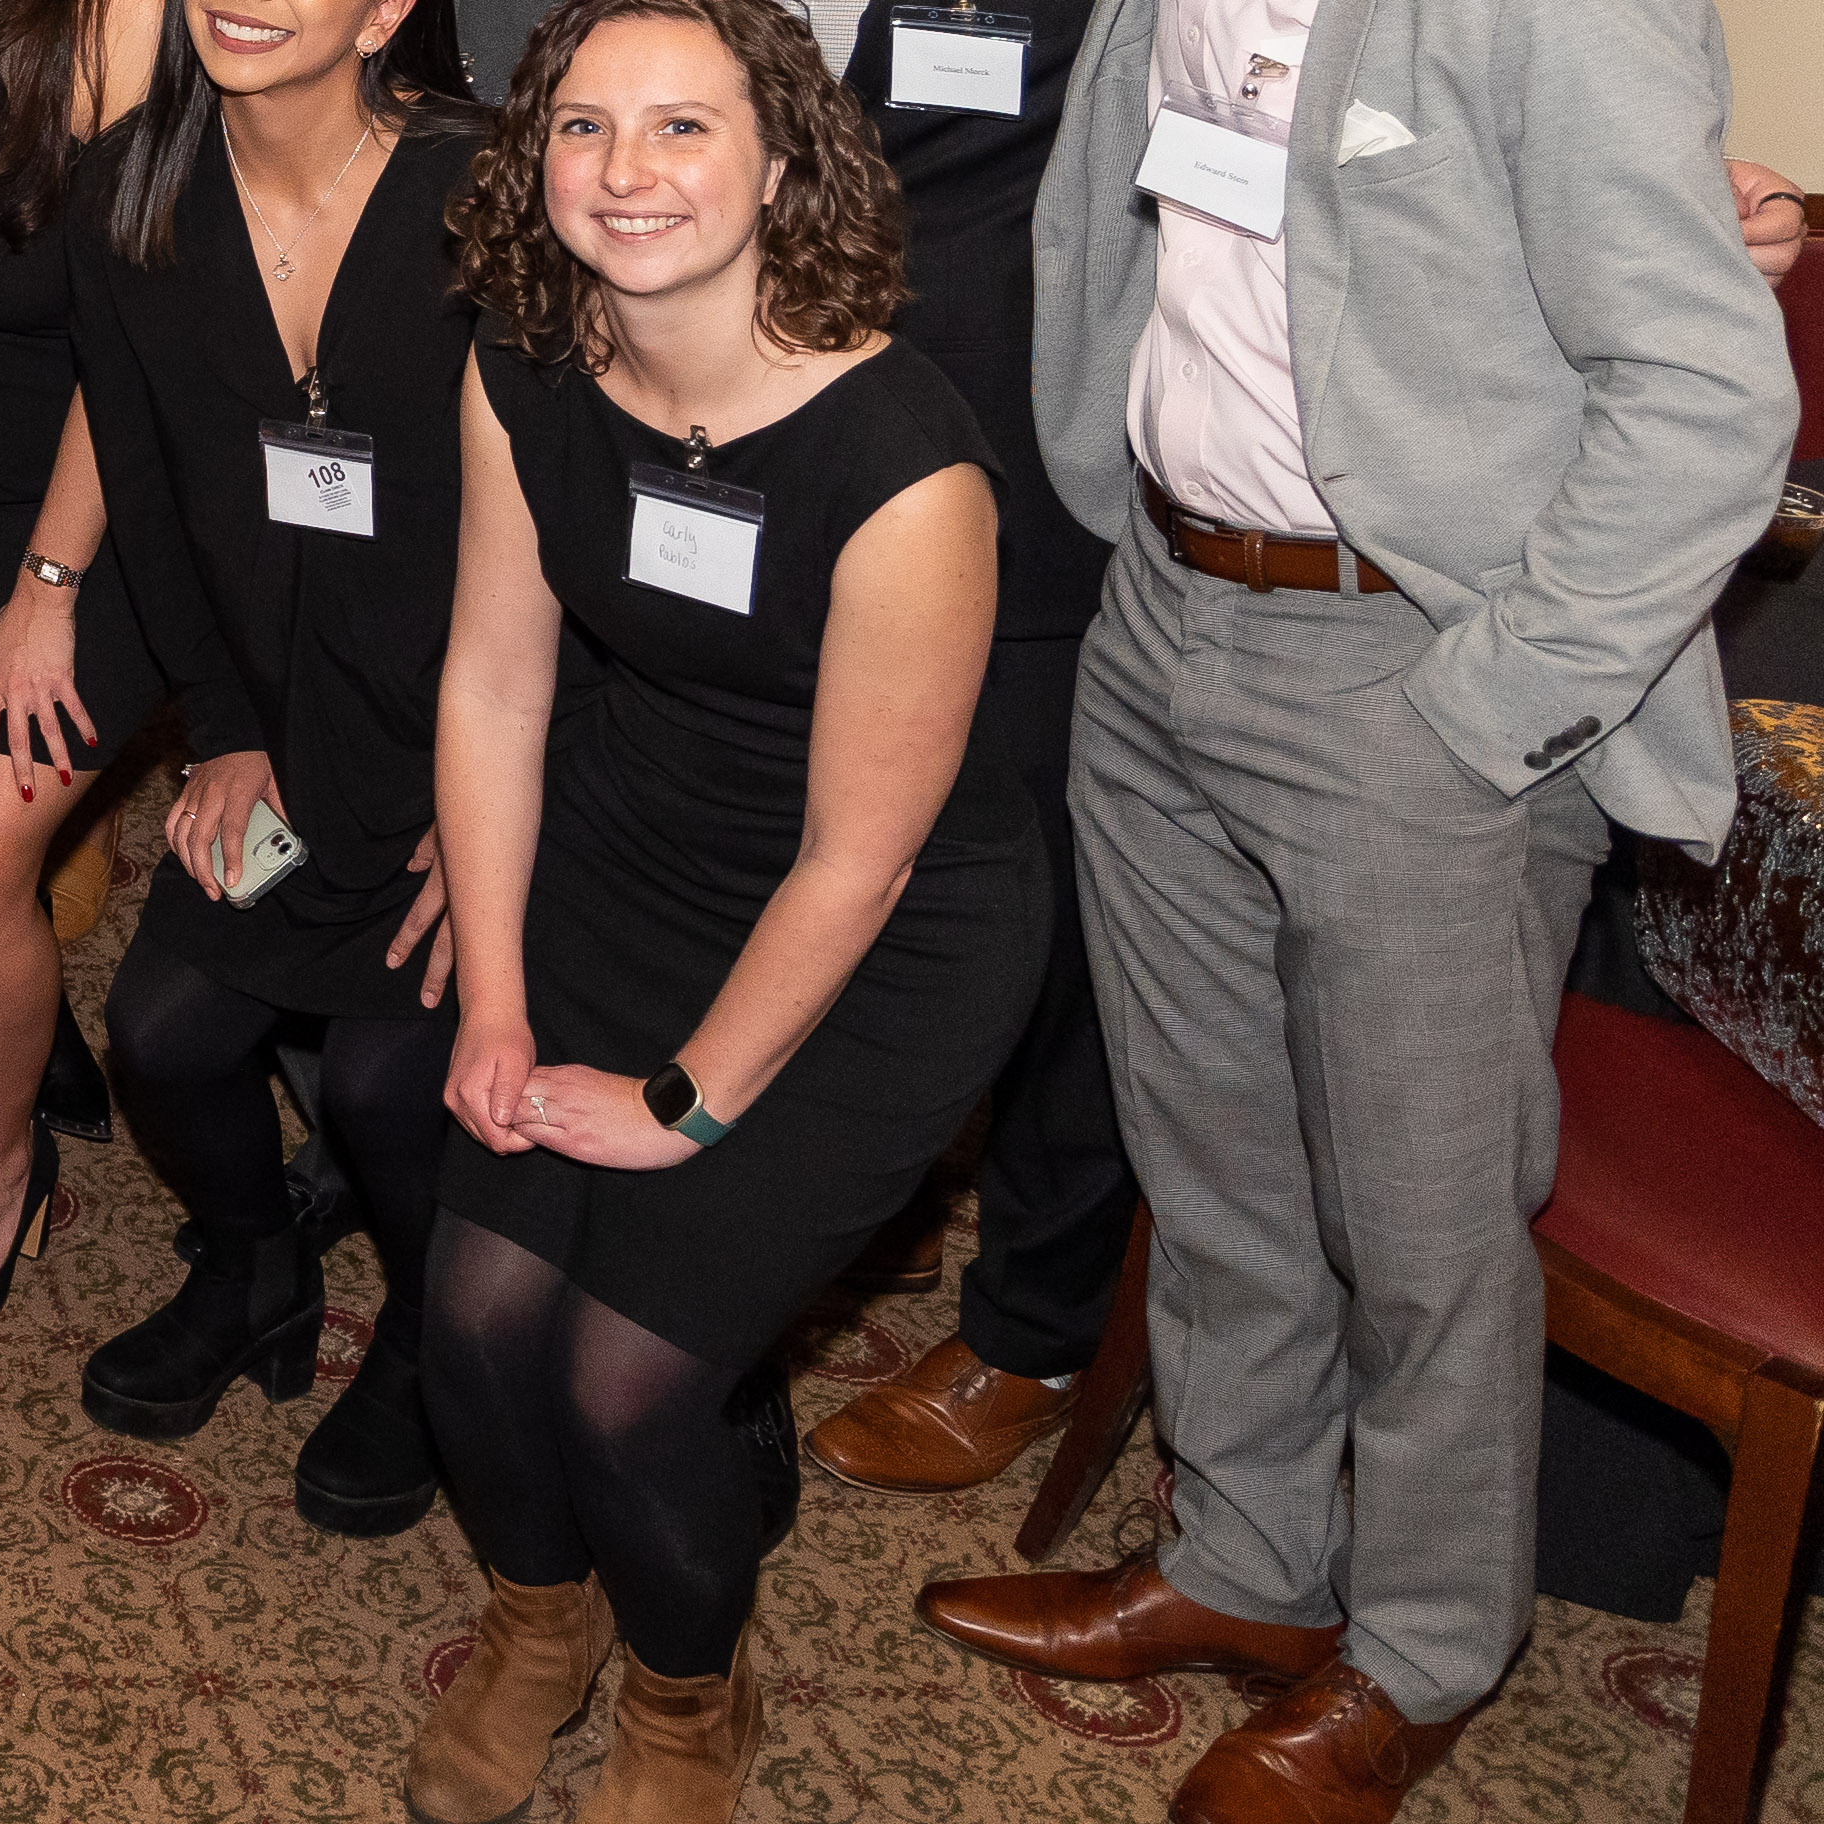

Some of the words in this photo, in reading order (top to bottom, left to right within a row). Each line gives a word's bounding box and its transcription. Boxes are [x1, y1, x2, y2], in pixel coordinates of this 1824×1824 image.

[1193, 160, 1227, 177] Edward
[307, 461, 346, 488] 108
[659, 543, 697, 569] Pablos
